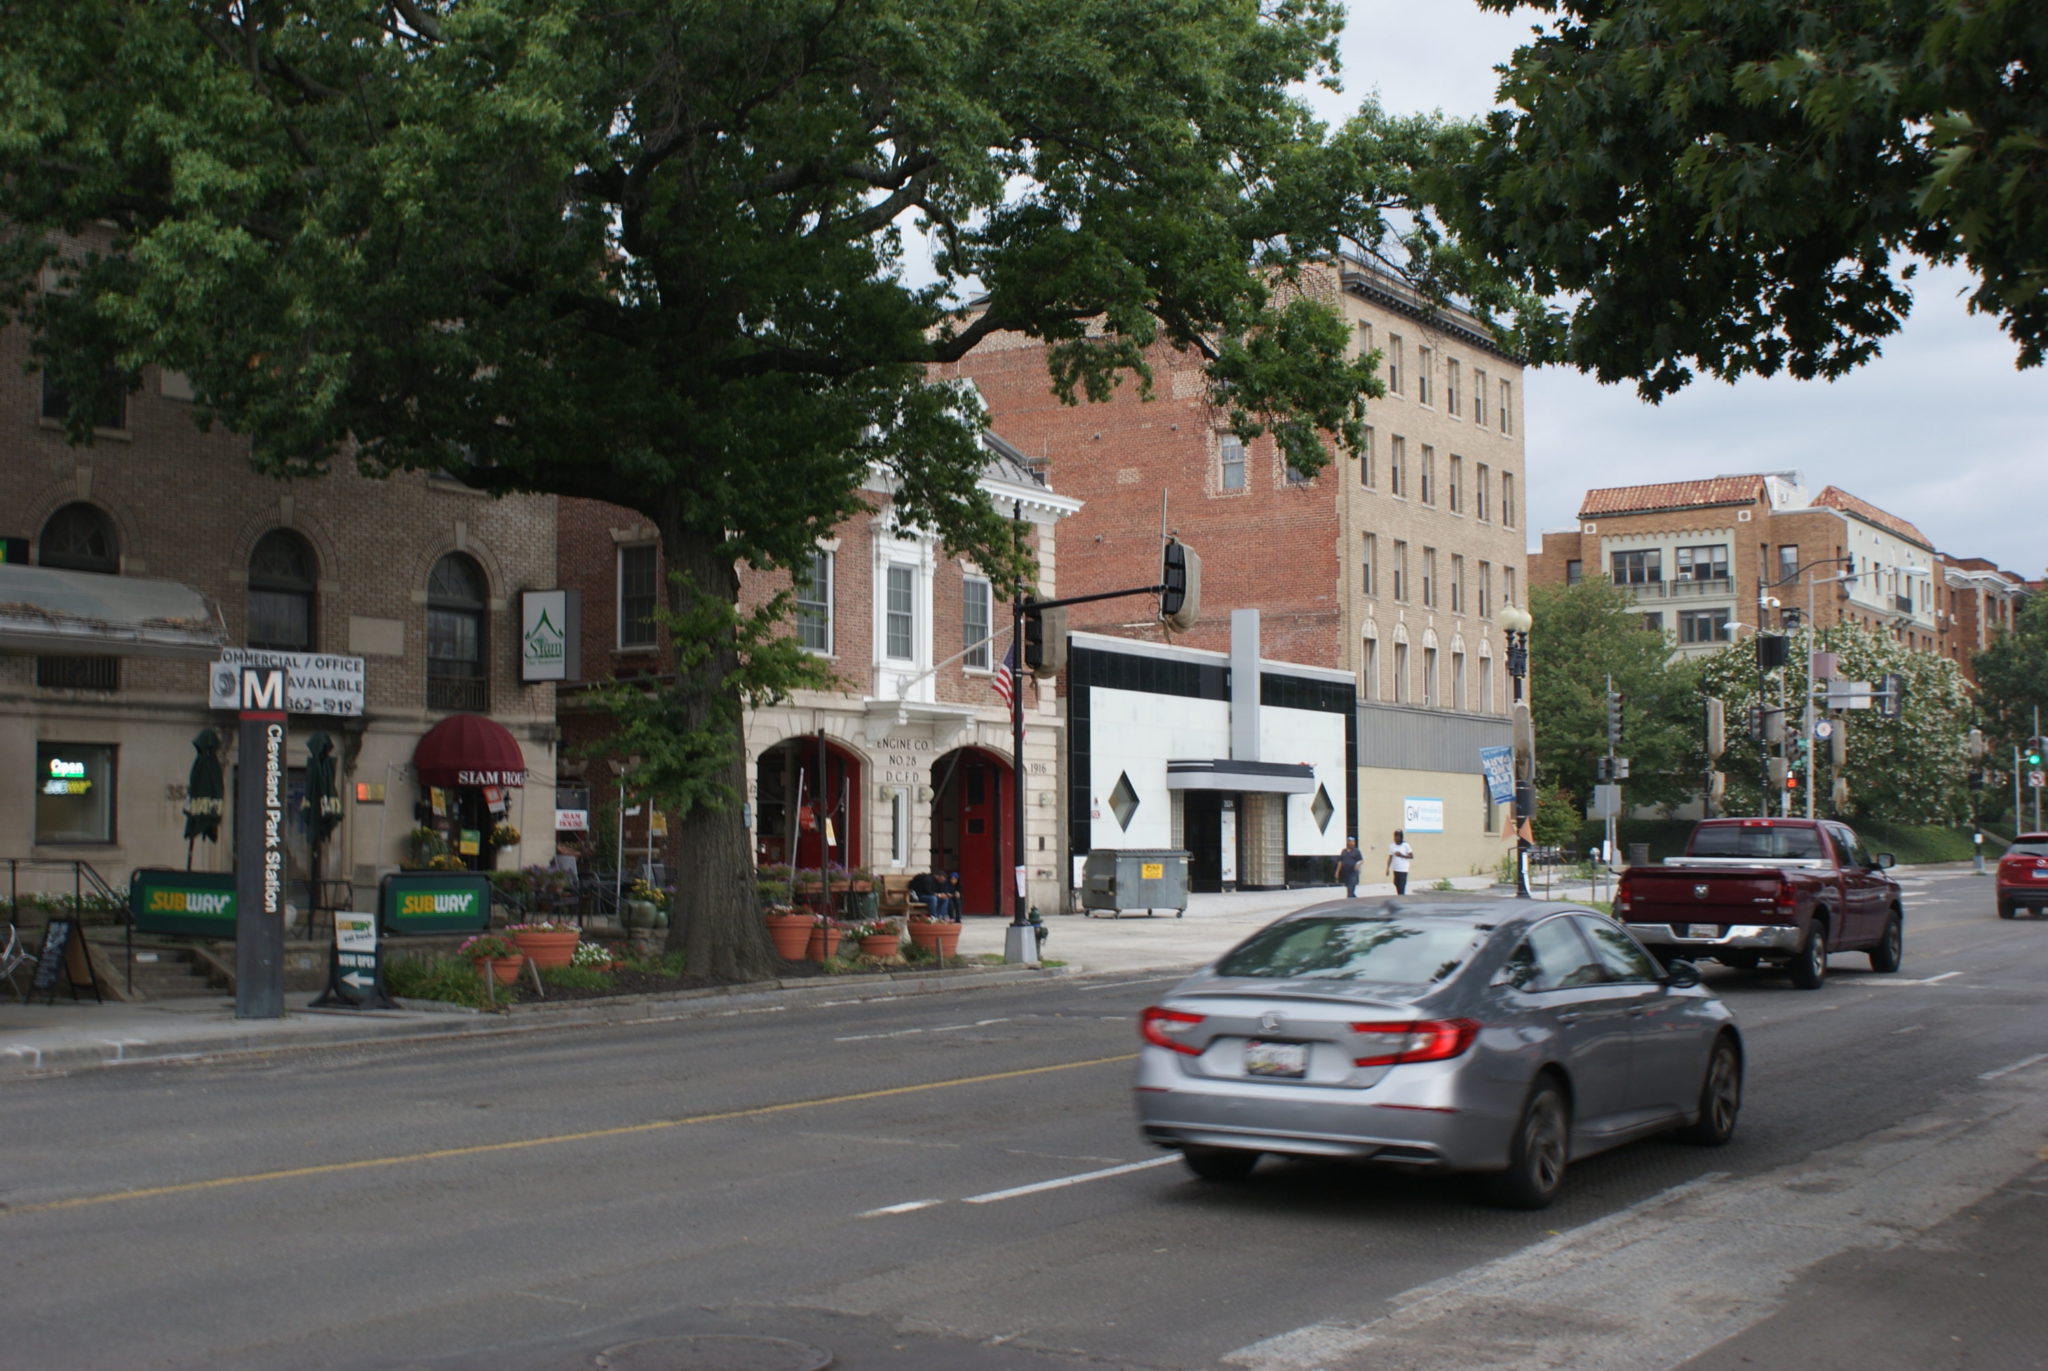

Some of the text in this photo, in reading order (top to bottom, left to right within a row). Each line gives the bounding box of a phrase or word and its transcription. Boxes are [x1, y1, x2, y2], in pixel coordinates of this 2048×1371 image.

[525, 641, 563, 659] Siam
[222, 650, 299, 669] OMMERCIAL
[315, 657, 362, 673] OFFICE
[243, 670, 284, 710] M
[287, 675, 363, 693] AVAILABLE
[877, 738, 911, 751] ENGINE
[50, 759, 84, 777] Open
[1030, 763, 1047, 774] 1916
[458, 770, 524, 785] SIAM HOU
[264, 723, 283, 914] Cleveland Park Station
[150, 891, 231, 914] SUBWAY
[402, 893, 474, 914] SUBWAY
